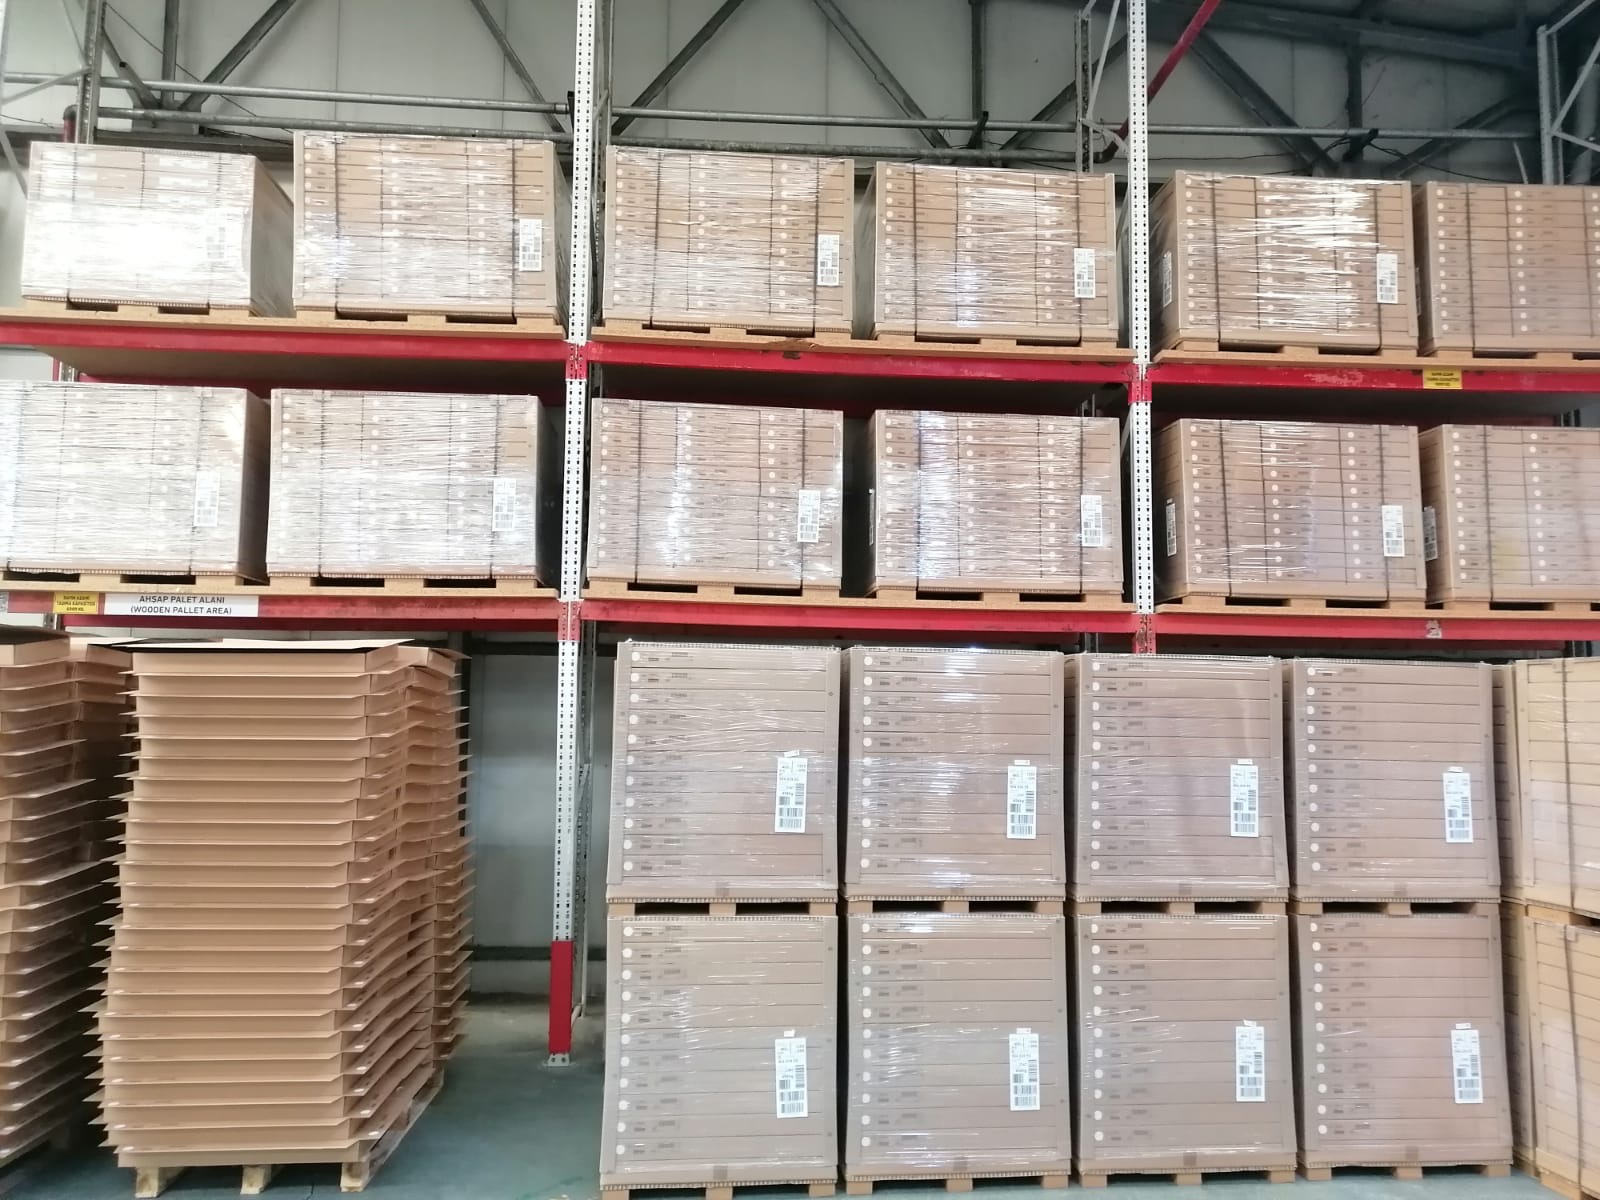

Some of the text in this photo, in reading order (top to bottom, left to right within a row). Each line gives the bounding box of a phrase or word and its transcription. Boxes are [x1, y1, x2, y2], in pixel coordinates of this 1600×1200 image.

[171, 596, 197, 604] PALET
[198, 596, 225, 604] ALANI
[130, 605, 232, 615] (WOODEN PALLET AREA)
